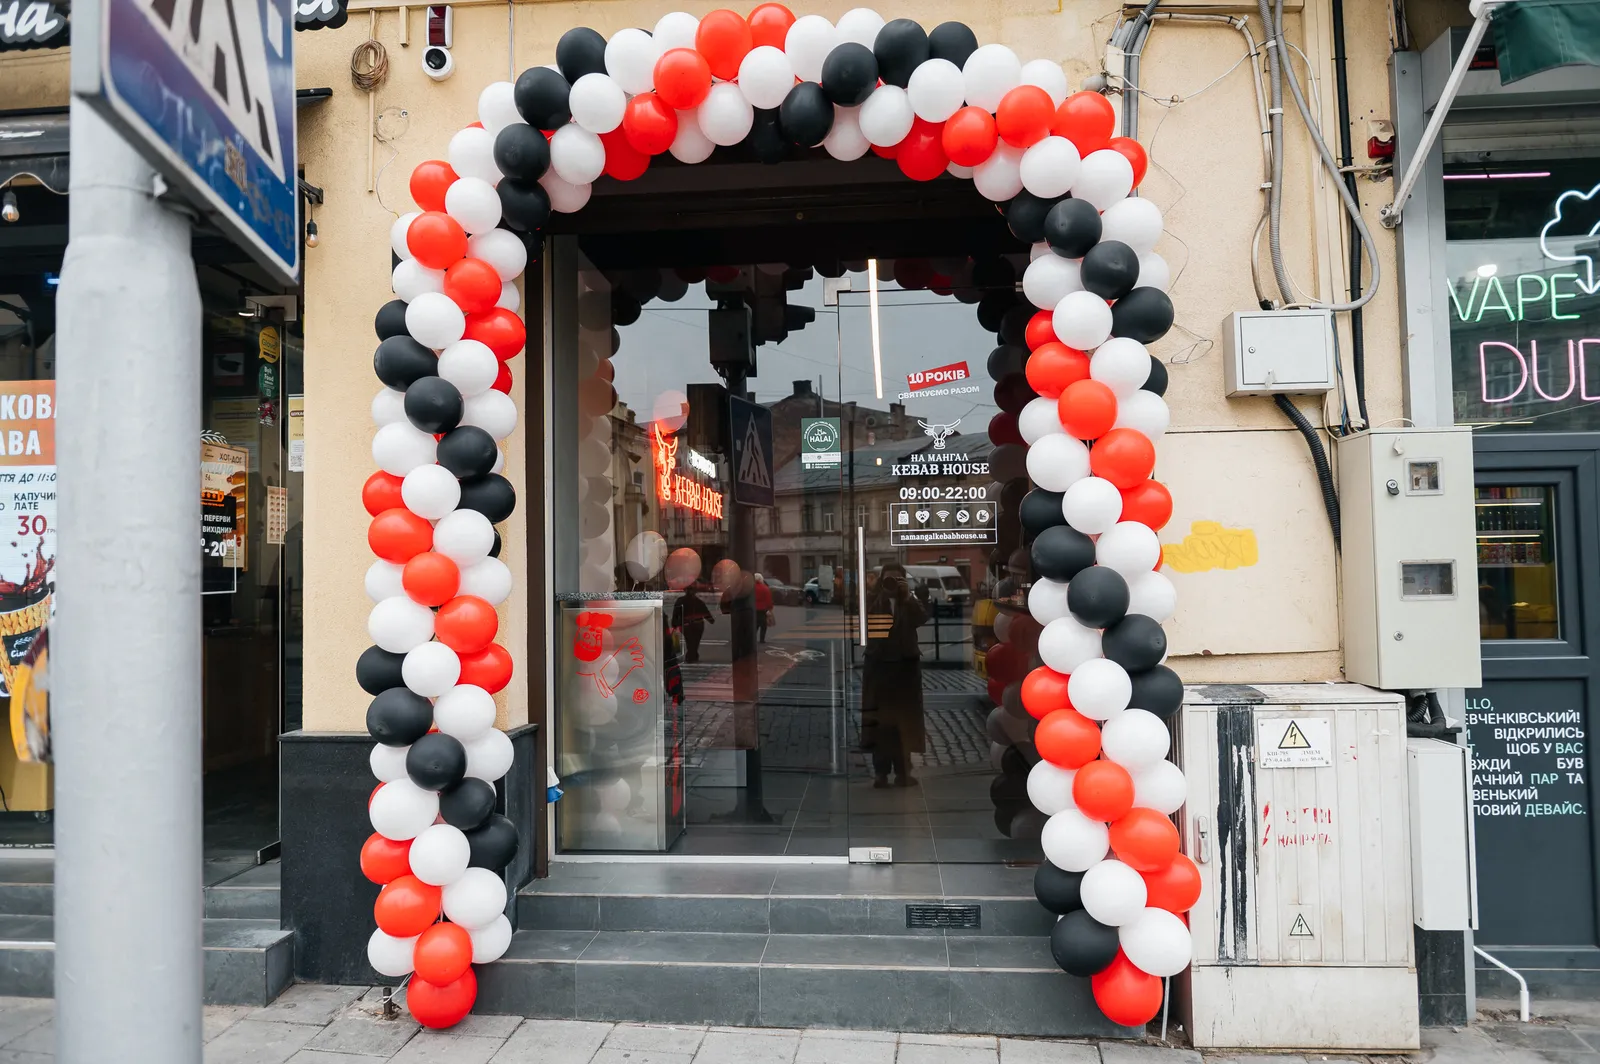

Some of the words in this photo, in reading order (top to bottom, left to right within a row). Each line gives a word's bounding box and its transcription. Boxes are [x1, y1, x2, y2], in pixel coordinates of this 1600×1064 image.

[1447, 273, 1580, 322] VAPE
[908, 372, 924, 384] 10
[925, 369, 966, 382] РОКІВ
[898, 389, 949, 400] СВЯТКУЄМО
[950, 386, 980, 395] РАЗОМ
[1, 394, 57, 421] КОВ
[809, 435, 832, 443] HALAL
[910, 454, 925, 462] НА
[927, 453, 969, 462] МАНГАЛ
[891, 464, 940, 476] KEBAB
[942, 463, 990, 475] HOUSE
[18, 473, 34, 484] ДО
[675, 474, 701, 511] KEBAB
[701, 486, 724, 520] HOUSE
[899, 486, 987, 500] 09:00-22:00
[13, 501, 39, 511] ЛАТЕ
[17, 514, 47, 536] 30
[204, 514, 231, 523] ПЕРЕРВИ
[202, 525, 233, 535] ВИХІДНИХ
[900, 532, 988, 542] namangalkebabhouse.ua
[1494, 727, 1585, 741] ВІДКРИЛИСЬ
[1506, 742, 1540, 757] ЩОБ
[1542, 742, 1553, 754] У
[1555, 742, 1584, 754] ВАС
[1556, 757, 1584, 769] БУВ
[1530, 773, 1559, 785] ПАР
[1566, 773, 1584, 784] ТА
[1524, 801, 1587, 817] ДЕВАЙС.
